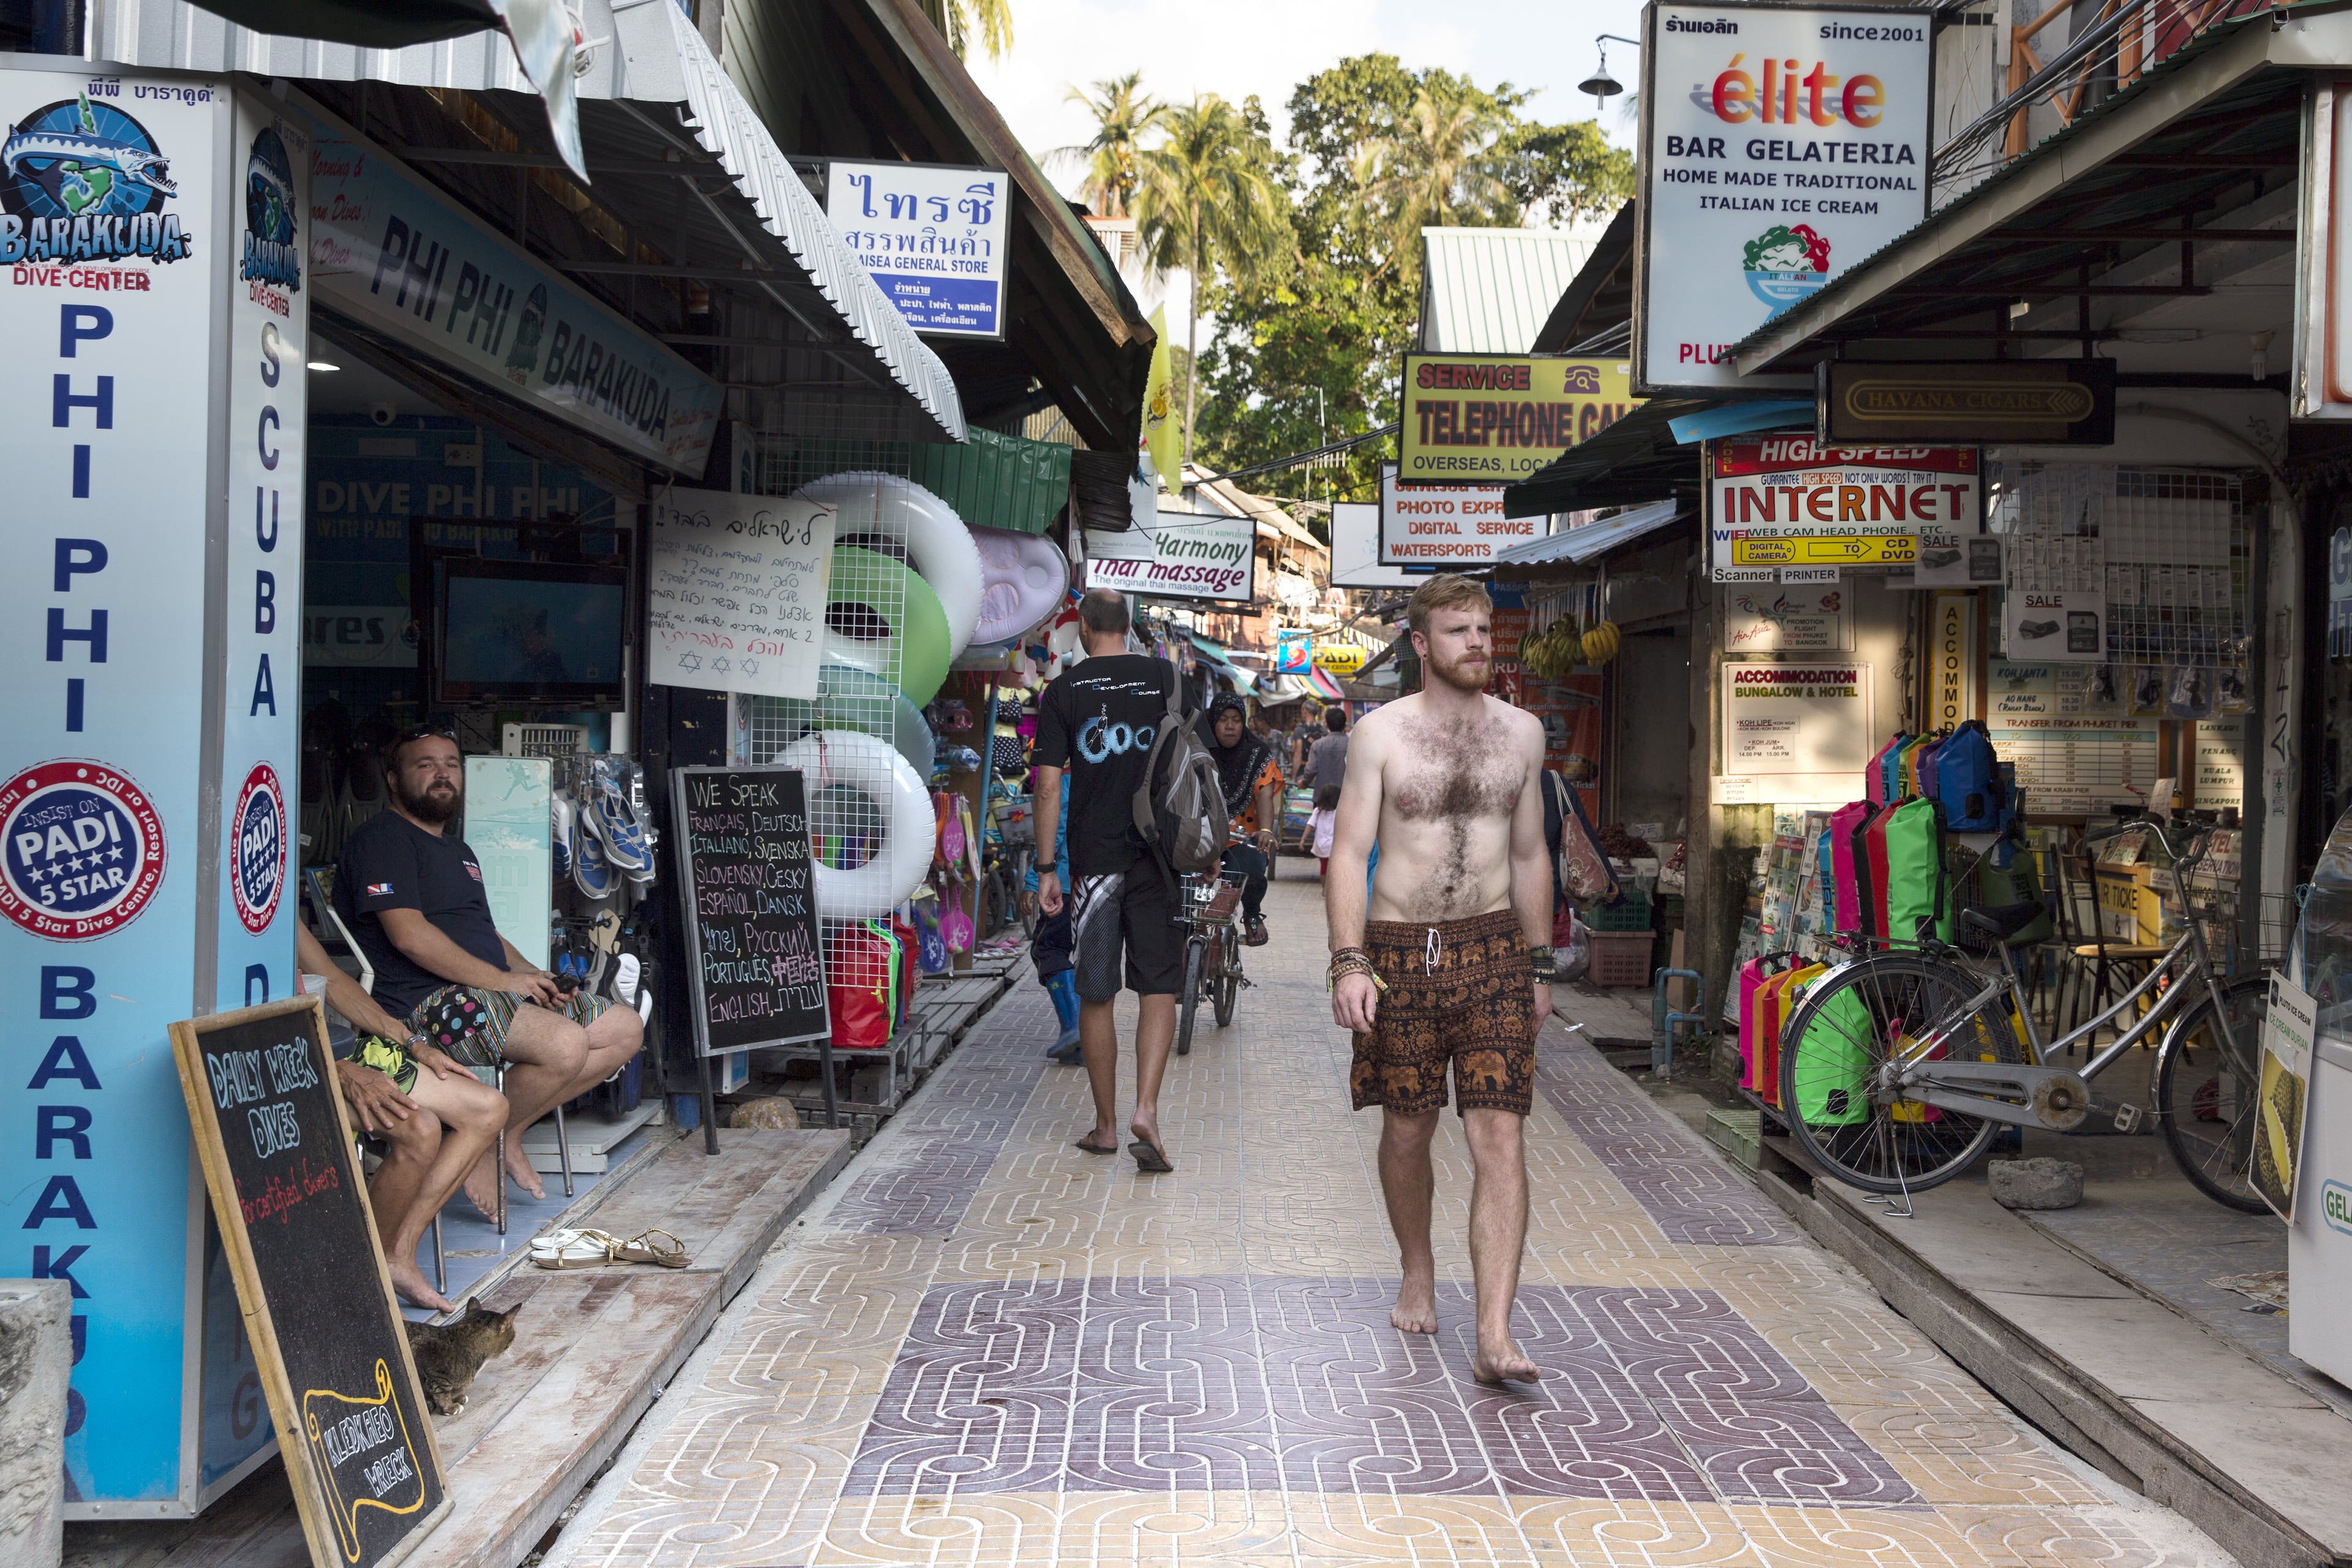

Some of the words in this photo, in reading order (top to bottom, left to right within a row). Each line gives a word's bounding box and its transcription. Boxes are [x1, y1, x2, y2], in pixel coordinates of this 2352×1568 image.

[1712, 53, 1885, 128] élite
[1666, 136, 1727, 159] BAR
[1746, 139, 1916, 165] GELATERIA
[354, 153, 366, 178] &
[1663, 169, 1717, 184] HOME
[1724, 172, 1777, 186] MADE
[1783, 173, 1917, 190] TRADITIONAL
[847, 173, 995, 225] ไทรซี
[1700, 196, 1775, 211] ITALIAN
[1781, 198, 1811, 213] ICE
[1817, 200, 1878, 214] CREAM
[0, 213, 192, 265] BARAKUDA
[844, 227, 991, 257] สรรพสินค้า
[245, 229, 300, 292] BARAKUDA
[895, 256, 947, 271] GENERAL
[951, 259, 988, 273] STORE
[1768, 272, 1807, 281] ITALIAN
[371, 214, 450, 323] PHI
[445, 261, 514, 357] PHI
[542, 319, 671, 442] BARAKUDA
[1417, 364, 1531, 391] SERVICE
[53, 304, 114, 499] PHI
[1869, 392, 1956, 408] HAVANA
[1967, 392, 2041, 409] CIGARS
[1415, 400, 1574, 448] TELEPHONE
[1414, 456, 1505, 472] OVERSEAS,
[1761, 474, 1800, 485] GUARANTEE
[1803, 473, 1820, 484] HIGH
[1821, 473, 1842, 484] SPEED
[1845, 473, 1860, 483] NOT
[1861, 473, 1879, 483] ONLY
[1913, 473, 1925, 483] TRY
[317, 480, 410, 514] DIVE
[427, 484, 495, 516] PHI
[512, 486, 579, 518] PHI
[1396, 501, 1454, 514] PHOTO
[1725, 485, 1969, 522] INTERNET
[250, 322, 280, 717] SCUBA
[726, 510, 827, 545] לישראלים
[1409, 522, 1461, 535] DIGITAL
[1476, 522, 1534, 535] SERVICE
[1714, 530, 1748, 541] WIFI
[1748, 528, 1777, 537] WEB
[1784, 527, 1814, 536] CAM
[1820, 527, 1856, 535] HEAD
[1923, 535, 1959, 546] SALE
[1156, 532, 1247, 568] Harmony
[1390, 543, 1491, 557] WATERSPORTS
[1844, 545, 1860, 553] TO
[1887, 539, 1909, 548] CD
[1882, 551, 1915, 560] DVD
[1094, 575, 1110, 584] The
[1114, 576, 1146, 590] original
[1150, 579, 1166, 589] thai
[1169, 582, 1209, 593] massage
[1147, 561, 1245, 593] massage
[1715, 568, 1772, 581] Scanner
[1785, 570, 1835, 580] PRINTER
[712, 597, 740, 611] אפשר
[750, 603, 767, 614] הכל
[2026, 595, 2062, 606] SALE
[778, 605, 813, 621] אצלנו
[46, 538, 108, 733] PHI
[805, 630, 813, 643] 2
[748, 639, 783, 656] והכל
[1313, 651, 1358, 663] PADI
[1734, 670, 1857, 684] ACCOMMODATION
[1735, 687, 1803, 698] BUNGALOW
[1807, 687, 1815, 698] &
[1819, 686, 1858, 697] HOTEL
[96, 772, 125, 793] IDC
[692, 777, 720, 808] WE
[728, 775, 778, 807] SPEAK
[21, 804, 74, 828] INSIST
[79, 797, 100, 814] ON
[753, 811, 807, 833] DEUTSCH
[15, 810, 122, 866] PADI
[140, 810, 159, 861] Resort
[243, 809, 276, 867] PADI
[755, 836, 809, 859] SVENSKA
[40, 884, 57, 906] 5
[60, 867, 128, 901] STAR
[250, 882, 255, 903] 5
[256, 861, 276, 897] STAR
[757, 890, 806, 914] DANSK
[19, 908, 32, 921] 5
[35, 915, 70, 933] Star
[76, 915, 114, 933] Dive
[2114, 914, 2121, 935] &
[2279, 997, 2291, 1011] PLUTO
[2297, 1011, 2311, 1027] CREAM
[2276, 1018, 2291, 1038] CREAM
[2291, 1030, 2309, 1052] DURIAN
[207, 1049, 266, 1109] DAILY
[265, 1036, 319, 1095] WRECK
[247, 1101, 300, 1159] DIVES
[256, 1166, 302, 1224] certified
[303, 1157, 339, 1196] divers
[364, 1447, 412, 1498] WRECK
